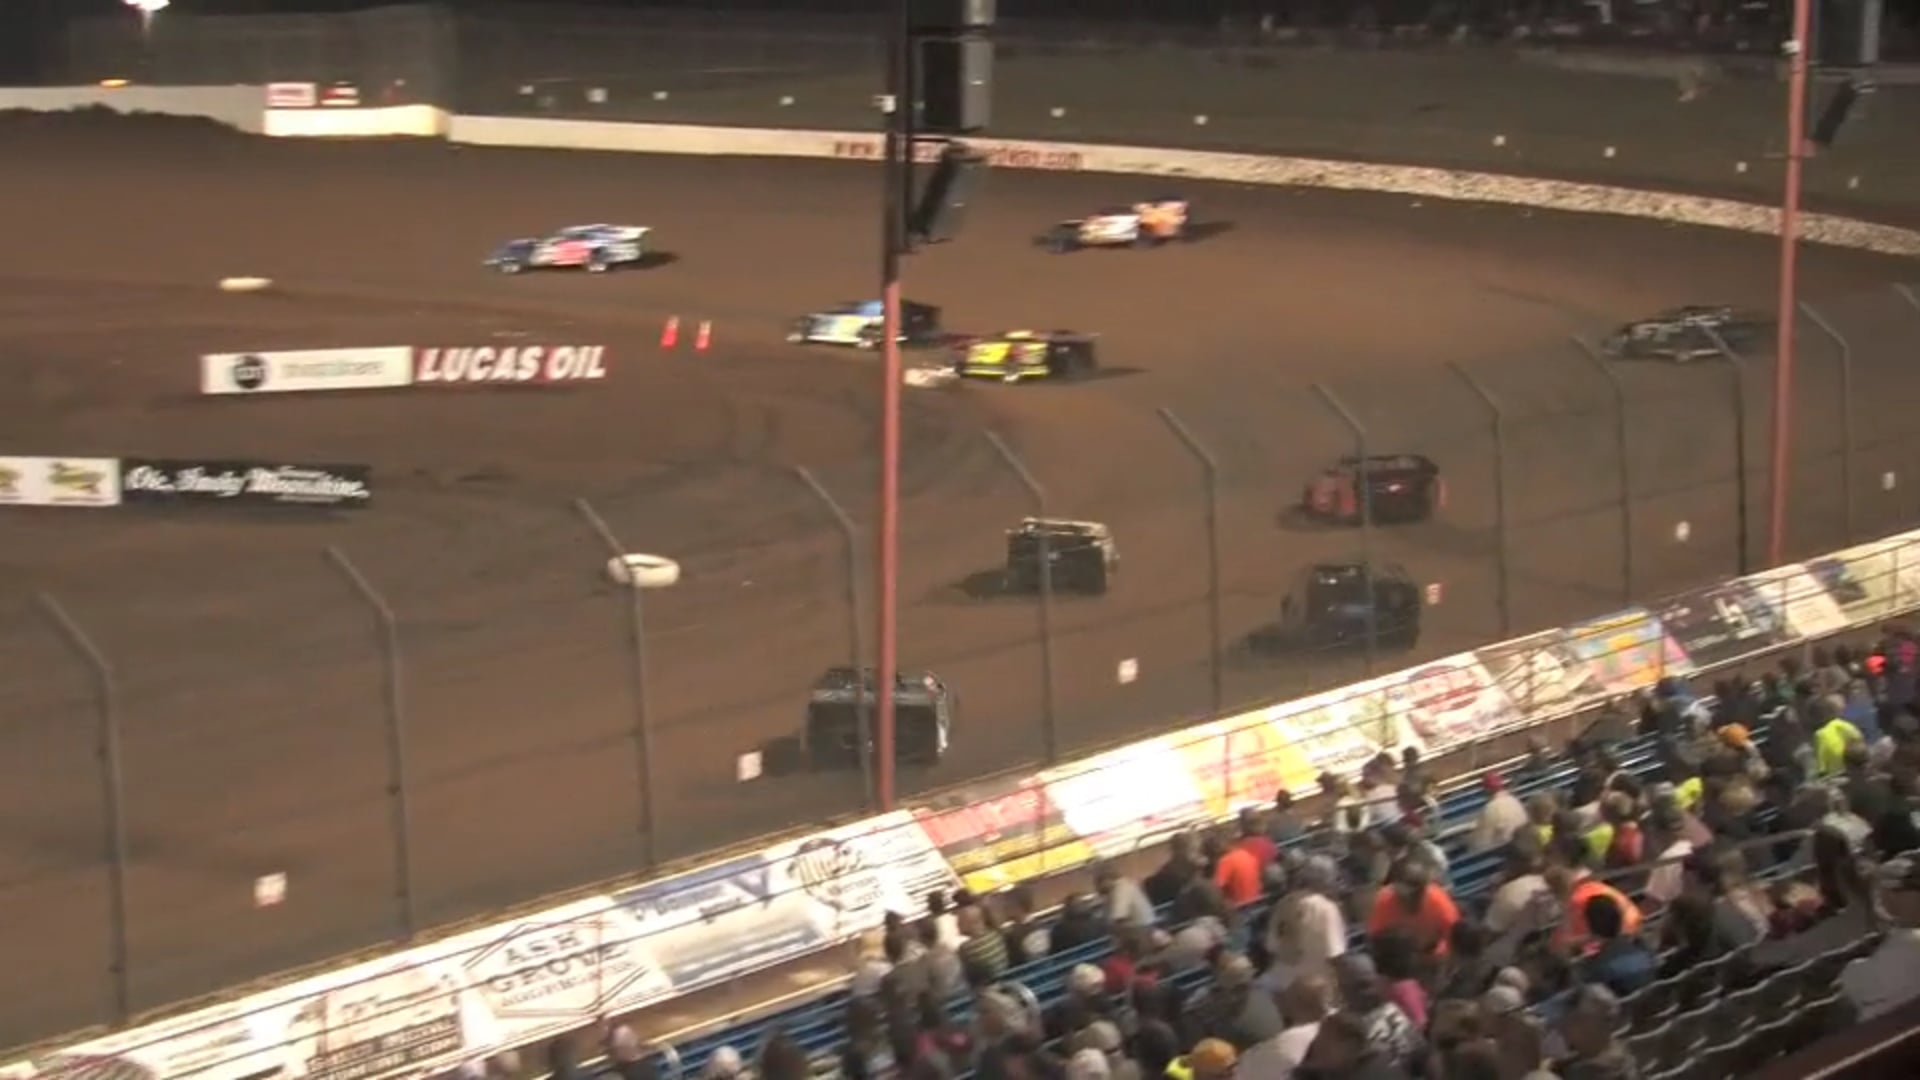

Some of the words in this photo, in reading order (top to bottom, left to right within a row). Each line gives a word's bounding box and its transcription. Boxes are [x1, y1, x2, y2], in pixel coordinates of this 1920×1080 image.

[419, 347, 540, 381] LUCAS
[548, 347, 606, 379] OIL
[505, 930, 583, 965] ASH
[489, 944, 628, 993] GROVE
